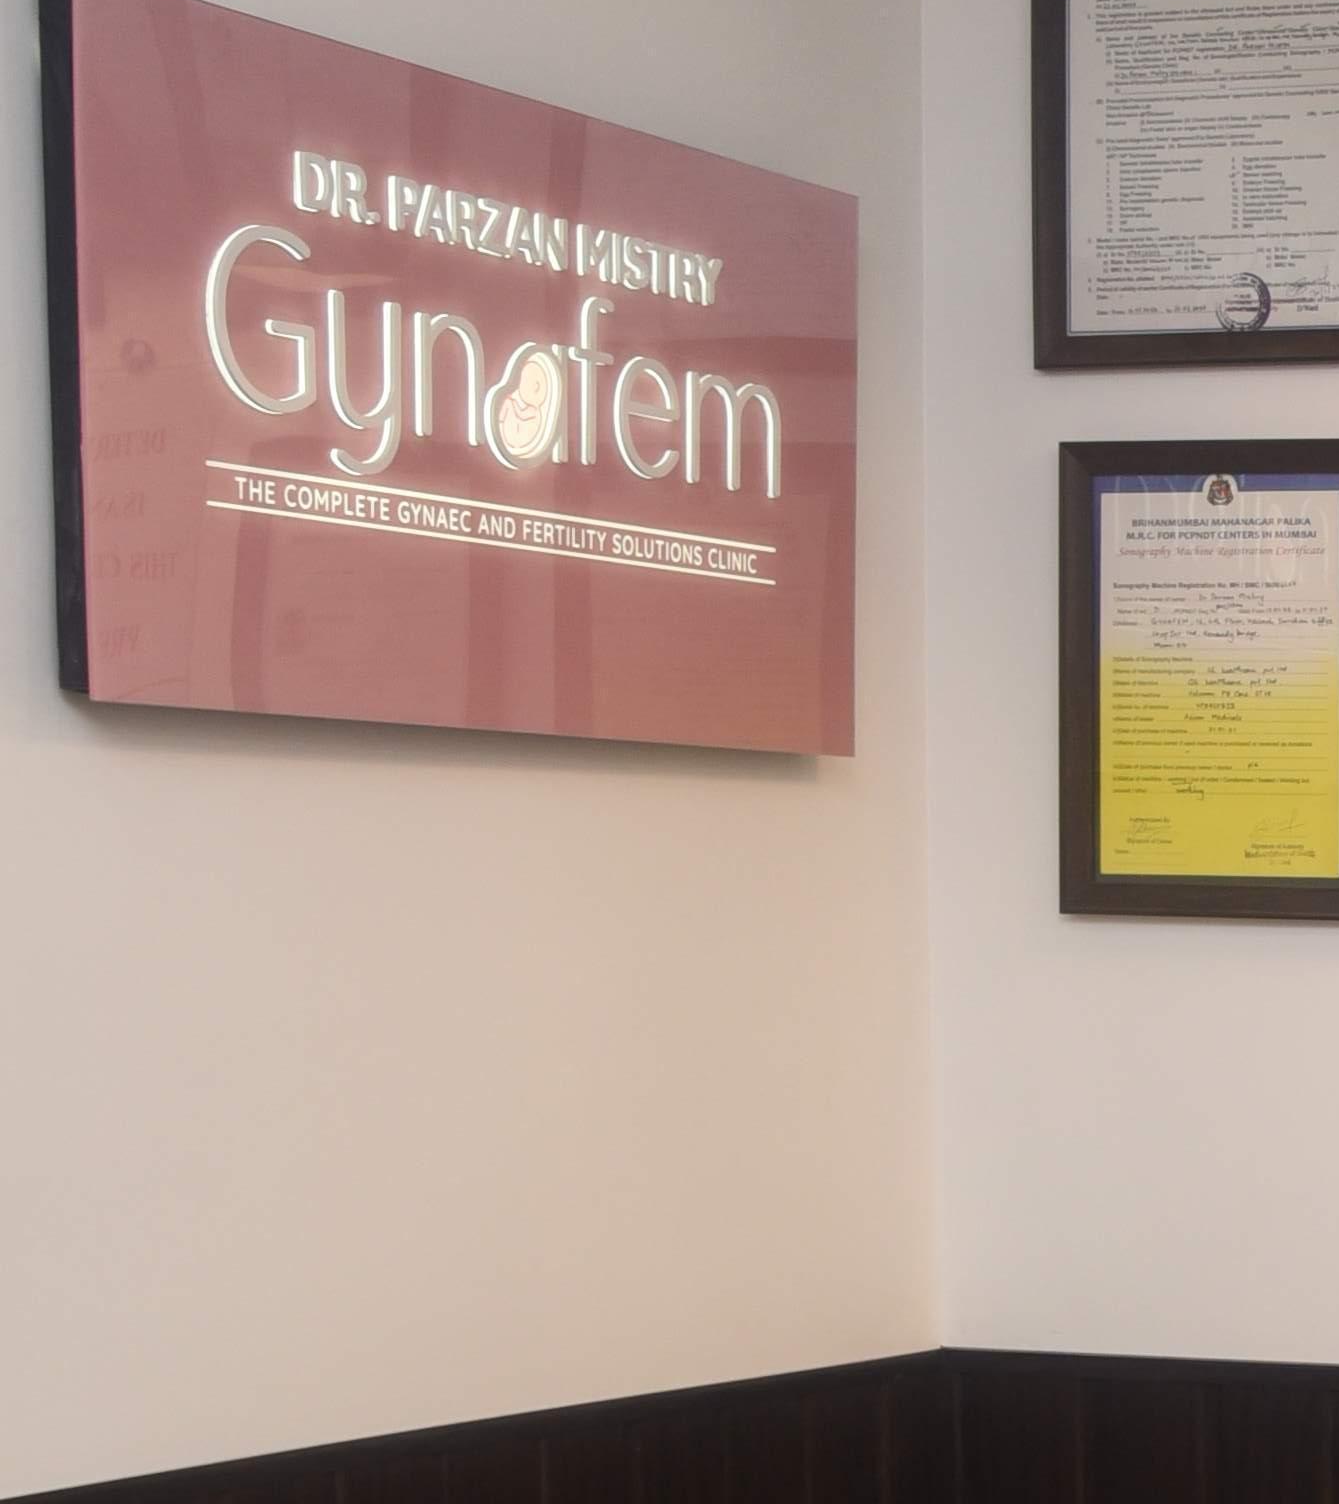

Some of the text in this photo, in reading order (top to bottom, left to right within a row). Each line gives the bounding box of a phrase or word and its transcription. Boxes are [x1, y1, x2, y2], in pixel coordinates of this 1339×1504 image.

[291, 150, 721, 304] DR. PARZAN MISTRY
[205, 223, 783, 499] Gynafem
[232, 477, 758, 573] THE COMPLETE GYNAEC AND FERTILITY SOLUTIONS CLINIC
